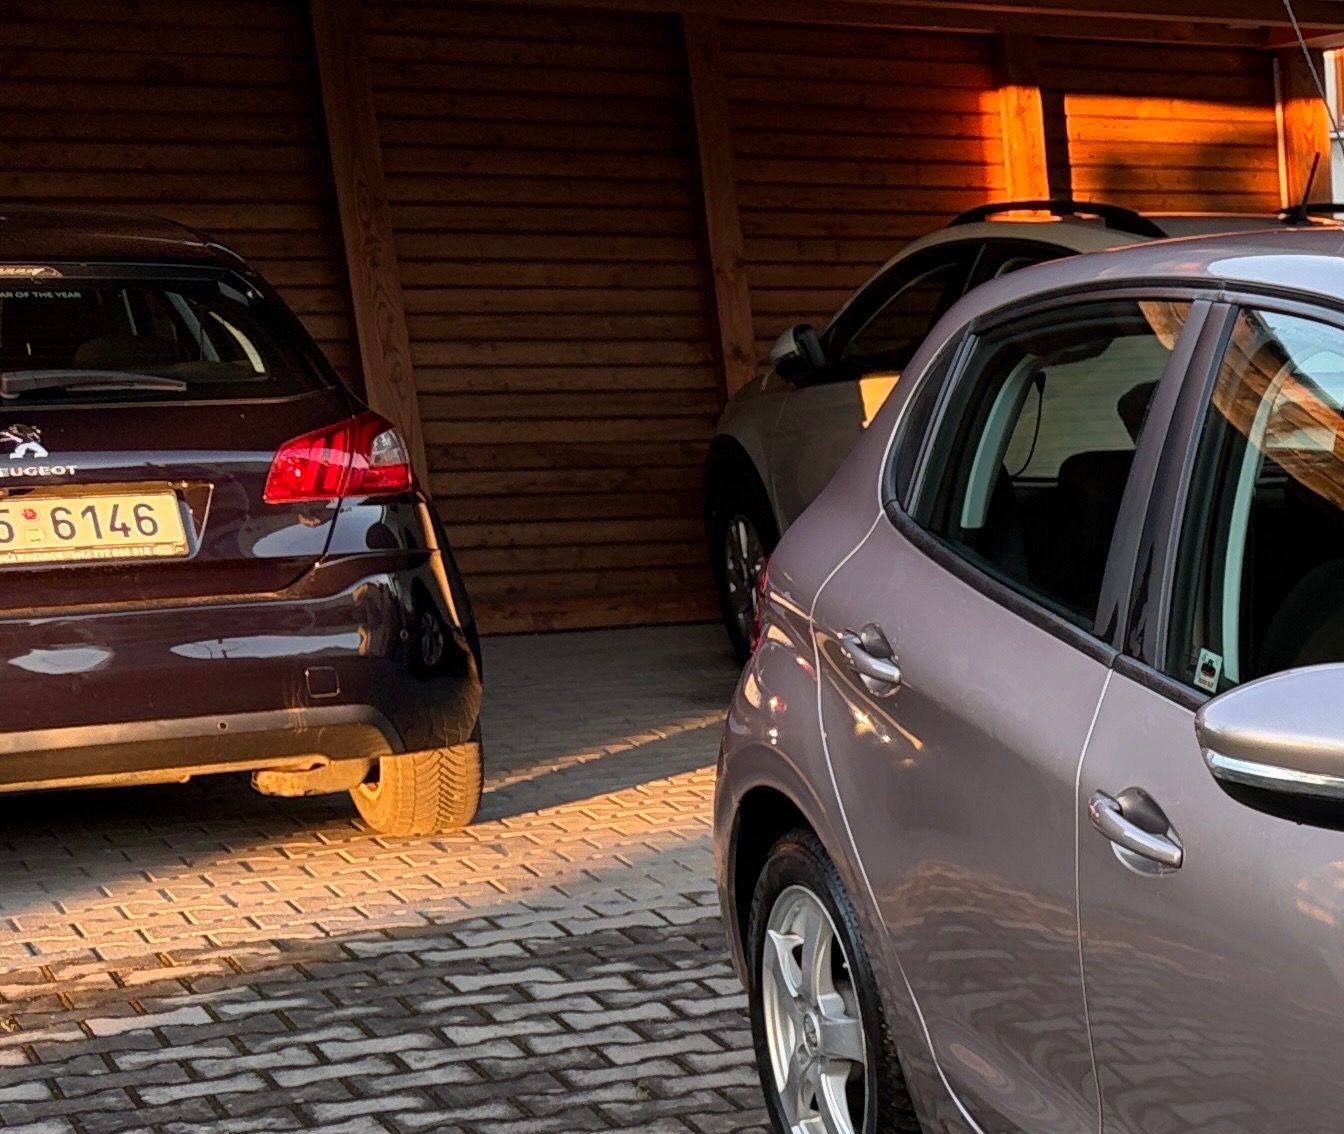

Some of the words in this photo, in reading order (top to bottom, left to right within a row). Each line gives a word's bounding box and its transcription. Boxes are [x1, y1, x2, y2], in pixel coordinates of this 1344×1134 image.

[14, 291, 30, 299] OF
[31, 291, 54, 299] THE
[54, 291, 81, 299] YEAR
[50, 503, 158, 540] 6146
